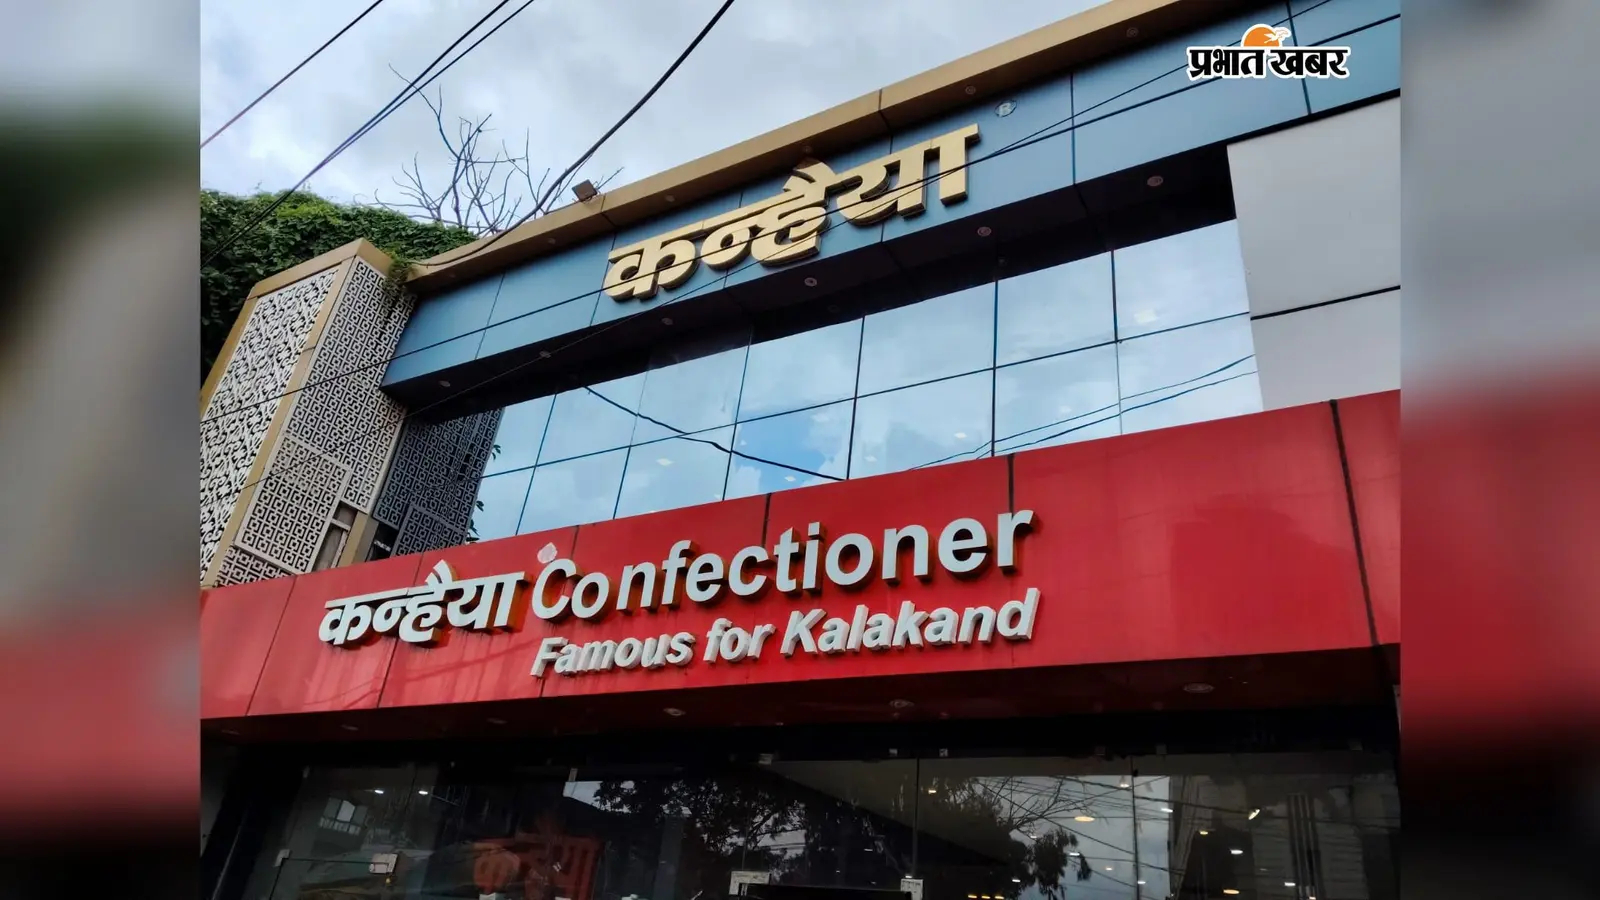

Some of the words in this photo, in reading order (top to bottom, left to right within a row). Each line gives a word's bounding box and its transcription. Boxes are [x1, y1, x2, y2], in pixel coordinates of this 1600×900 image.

[605, 125, 980, 302] कन्हैया
[319, 561, 528, 646] कन्हैया
[531, 509, 1035, 622] Confectioner
[531, 633, 697, 679] Famous
[703, 618, 776, 664] for
[781, 588, 1041, 655] Kalakand
